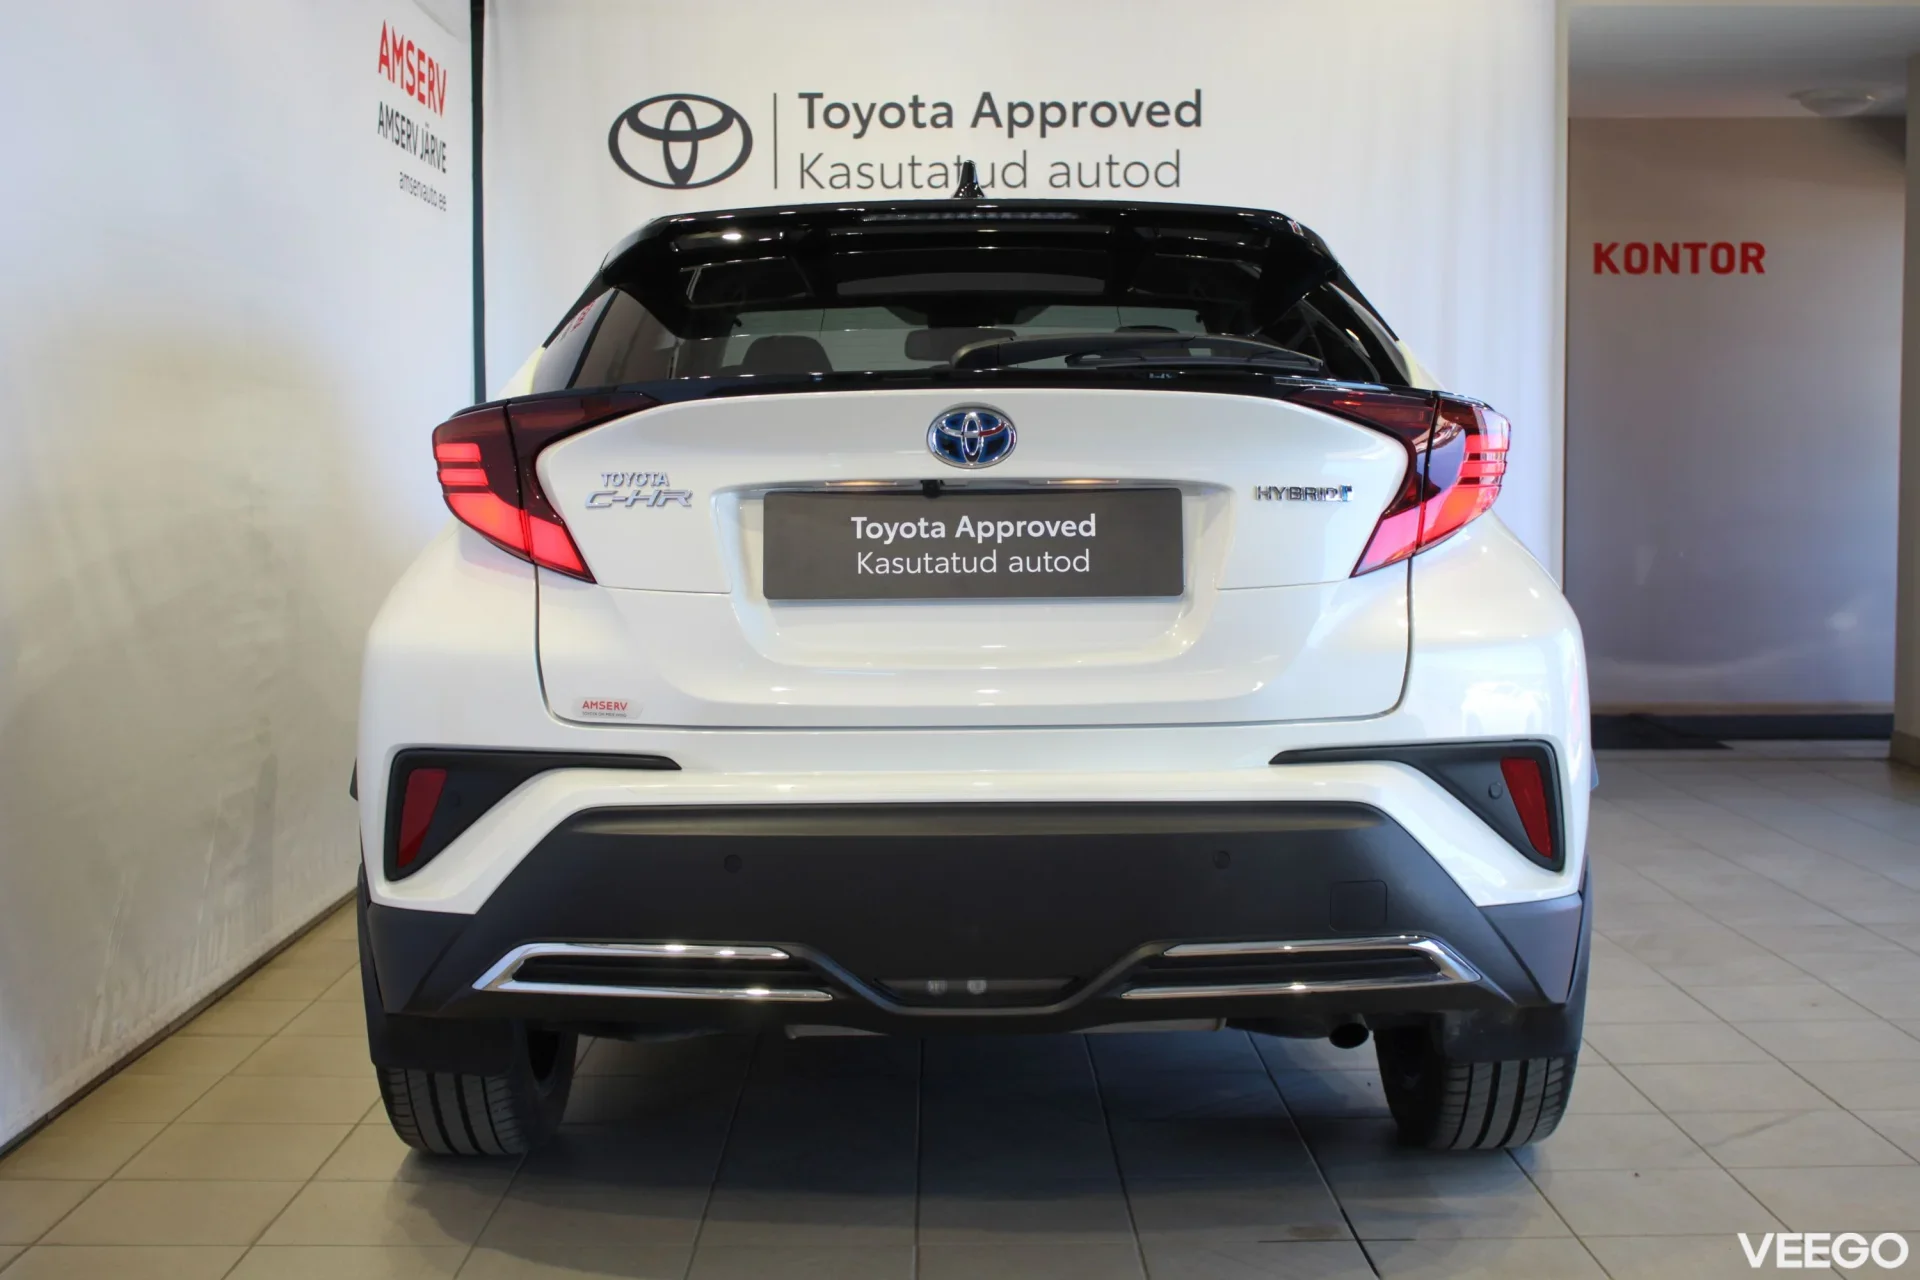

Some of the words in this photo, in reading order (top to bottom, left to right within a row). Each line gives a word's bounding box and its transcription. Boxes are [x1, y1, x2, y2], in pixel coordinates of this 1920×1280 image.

[378, 19, 447, 118] AMSERV
[798, 92, 955, 139] Toyota
[970, 89, 1203, 138] Approved
[377, 101, 420, 156] AMSERV
[419, 122, 447, 174] JÄRVE
[799, 150, 1028, 190] Kasutatud
[1048, 149, 1182, 189] autod
[1592, 241, 1767, 275] KONTOR
[601, 472, 671, 488] TOYOTA
[1254, 484, 1339, 502] HYBRID
[584, 489, 694, 509] C-HR
[850, 516, 946, 545] Toyota
[955, 513, 1098, 544] Approved
[856, 549, 998, 575] Kasutatud
[1008, 549, 1091, 574] autod
[582, 700, 629, 712] AMSERV
